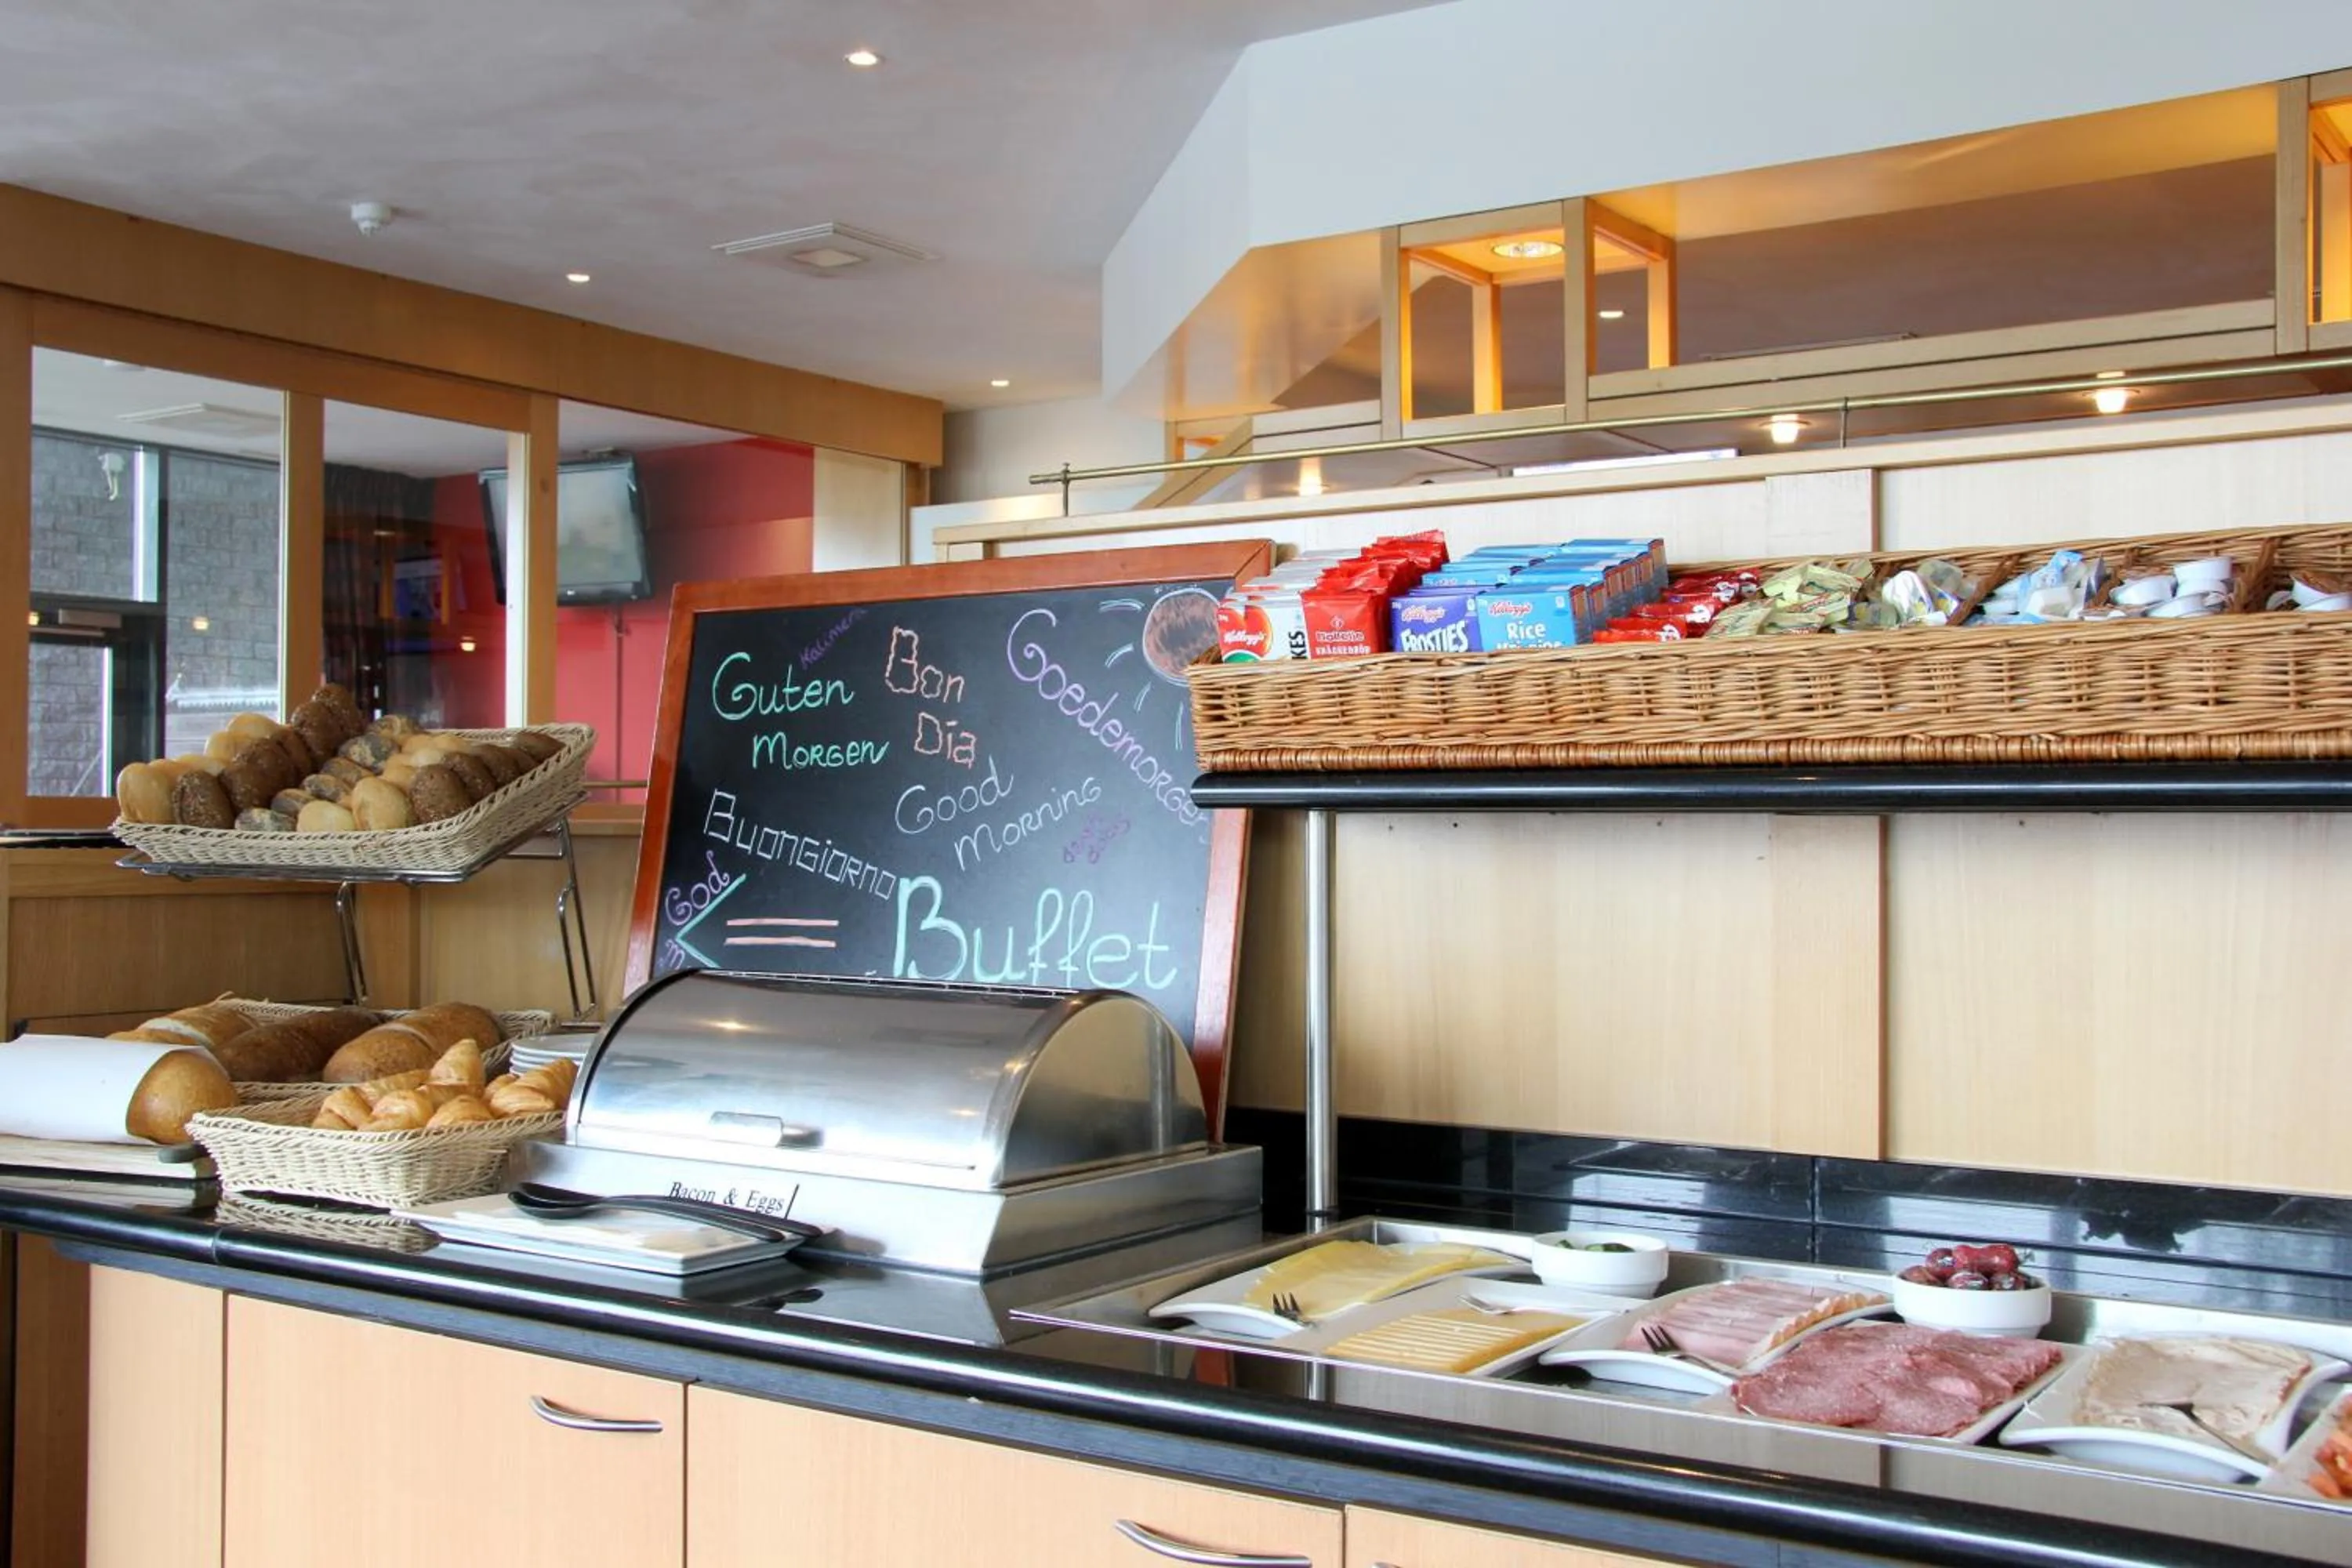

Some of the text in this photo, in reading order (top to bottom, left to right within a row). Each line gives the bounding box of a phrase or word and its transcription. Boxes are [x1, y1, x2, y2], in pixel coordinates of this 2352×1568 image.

[884, 626, 965, 703] Bon
[1506, 620, 1547, 641] Rice
[712, 652, 856, 720] Guten
[895, 753, 1014, 835] Good
[892, 875, 1178, 990] Buffet
[668, 1181, 785, 1214] Bacon & Eggs
